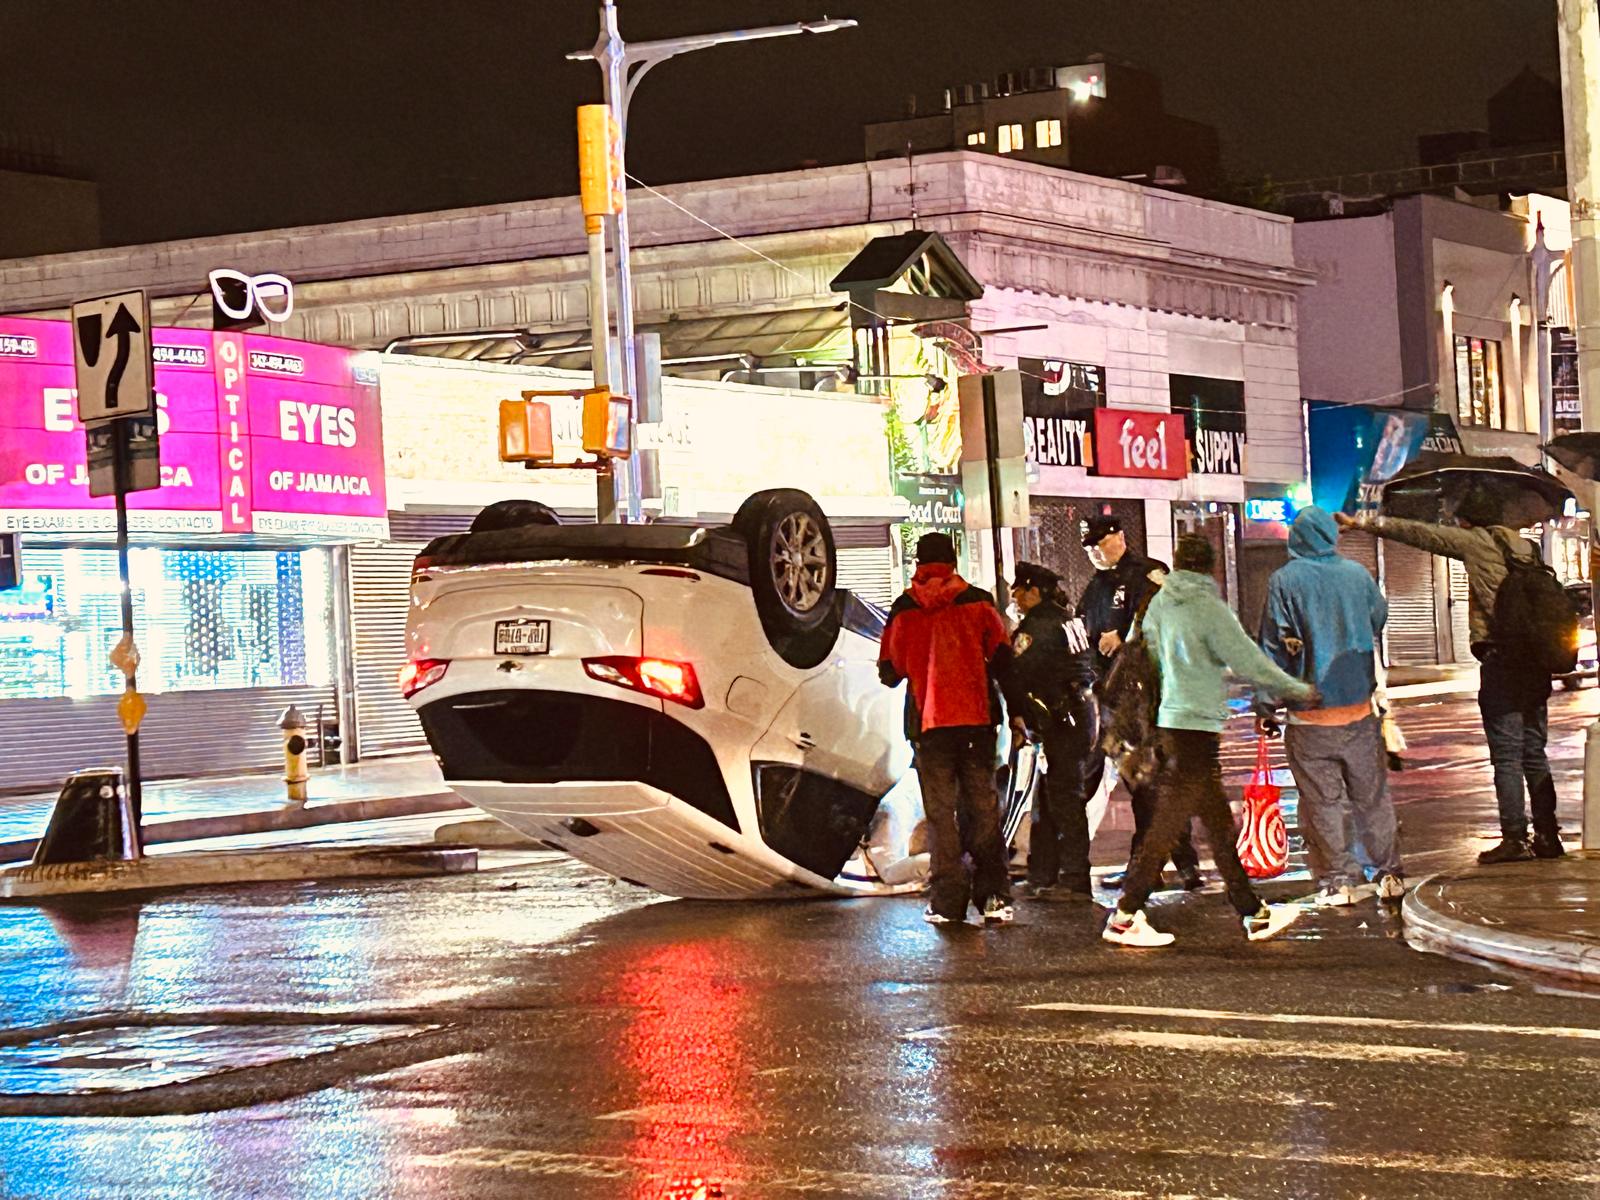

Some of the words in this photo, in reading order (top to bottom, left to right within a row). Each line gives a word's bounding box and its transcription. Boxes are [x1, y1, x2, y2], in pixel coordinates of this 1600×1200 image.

[221, 341, 245, 525] OPTICAL
[279, 400, 357, 447] EYES
[1023, 416, 1087, 466] BEAUTY
[1120, 418, 1167, 471] feel
[25, 463, 65, 485] OF
[1195, 427, 1246, 474] SUPPLY
[269, 470, 294, 491] OF
[296, 472, 372, 496] JAMAICA
